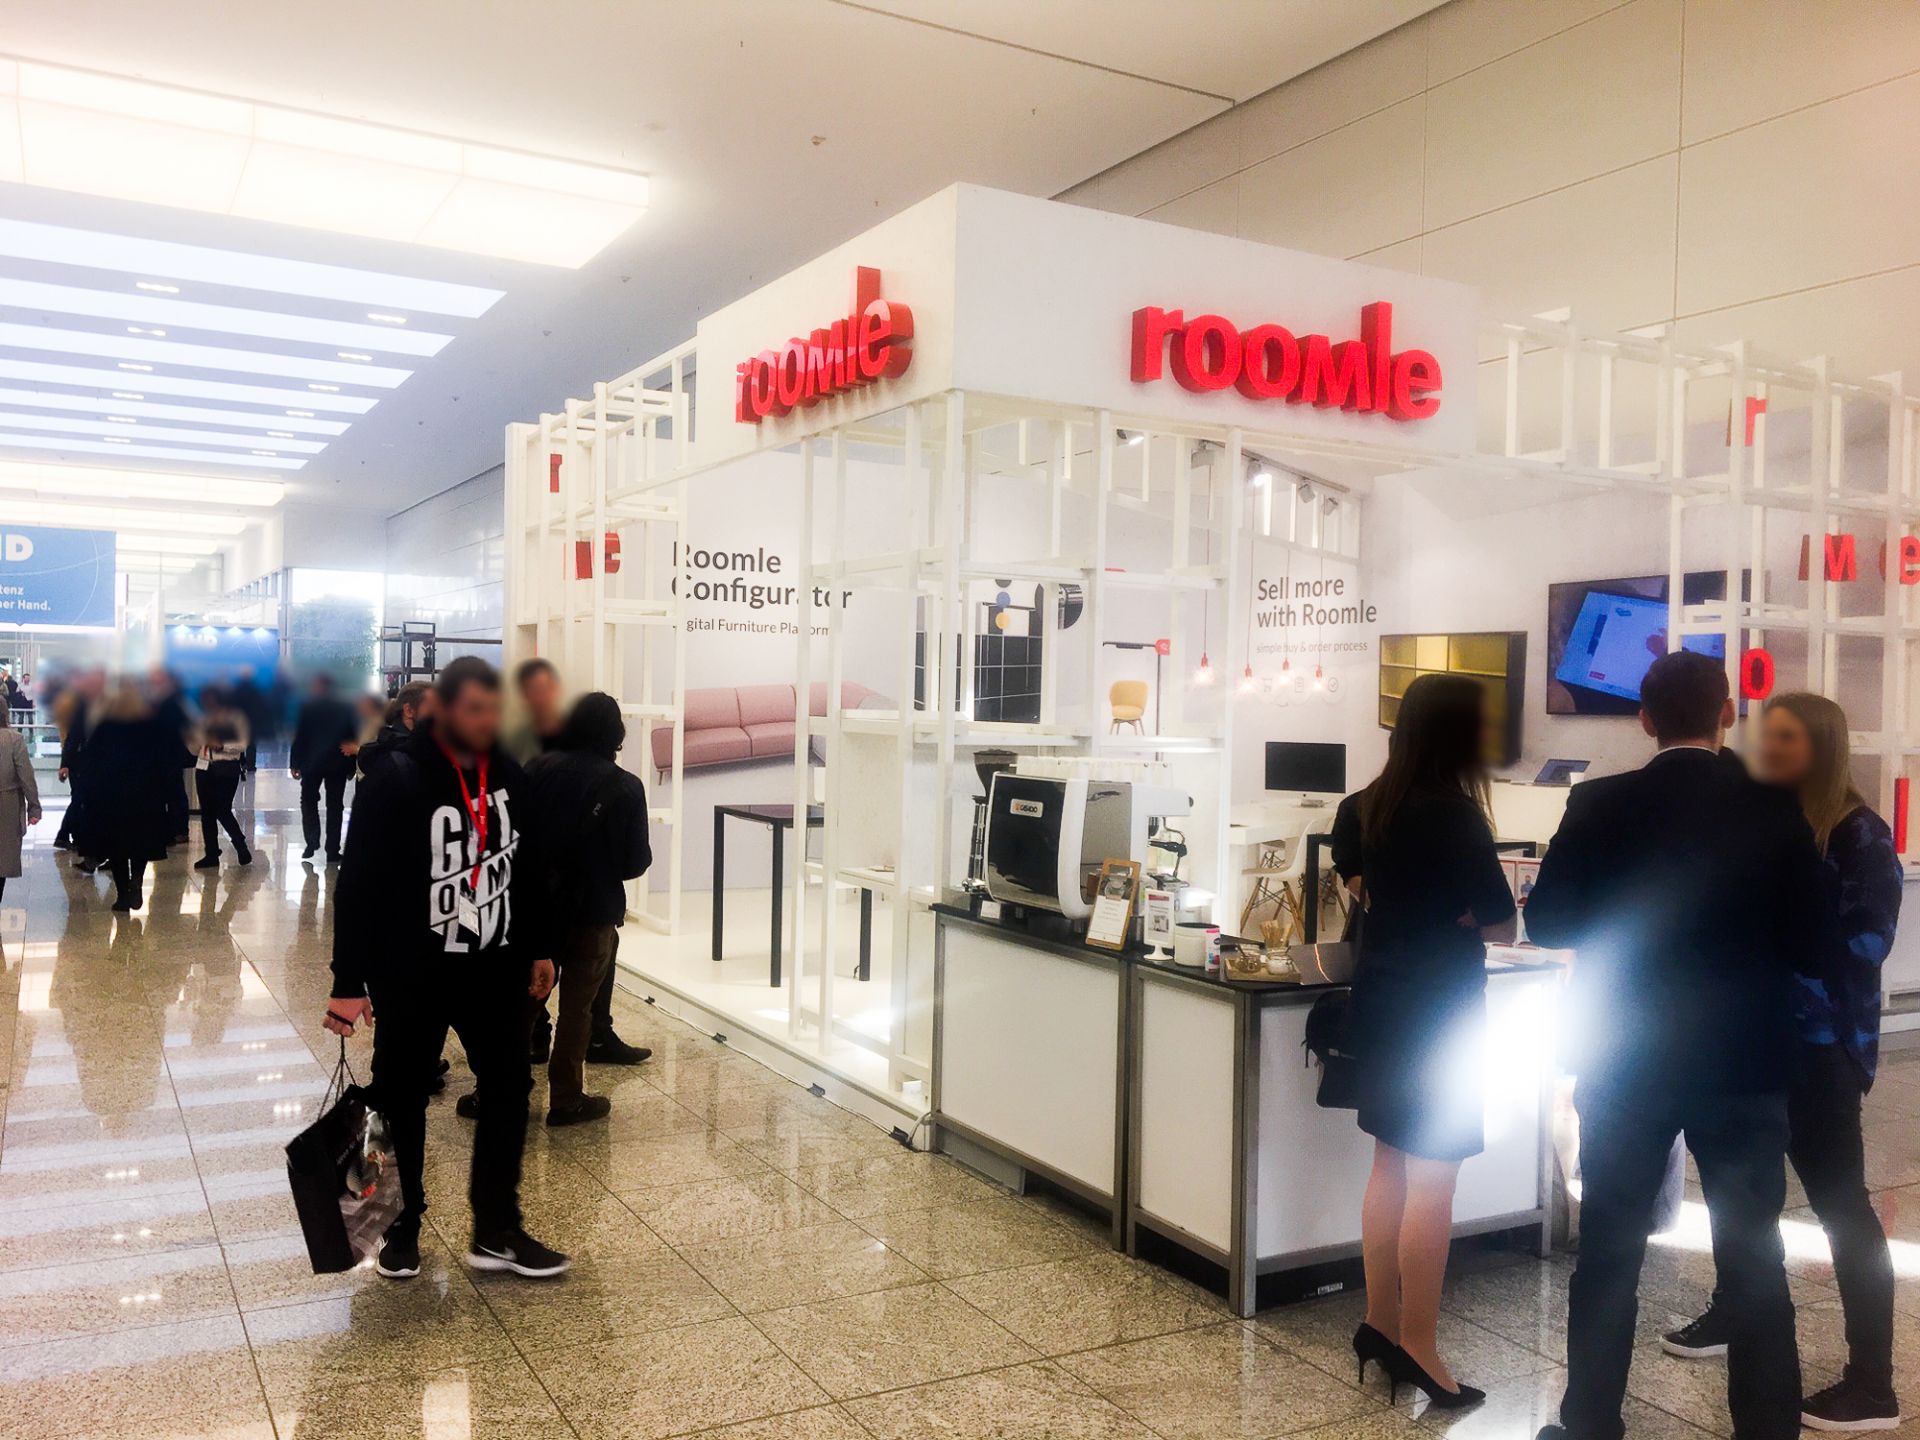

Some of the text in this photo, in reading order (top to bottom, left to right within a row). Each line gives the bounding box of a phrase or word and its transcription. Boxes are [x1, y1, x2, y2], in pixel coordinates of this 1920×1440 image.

[1130, 300, 1443, 422] roomle
[0, 534, 34, 561] D
[1257, 577, 1344, 601] Sell more
[18, 600, 51, 610] Hand.
[1257, 600, 1377, 628] with Roomle
[718, 619, 777, 634] Furniture
[1309, 641, 1333, 652] order
[1334, 641, 1368, 653] process
